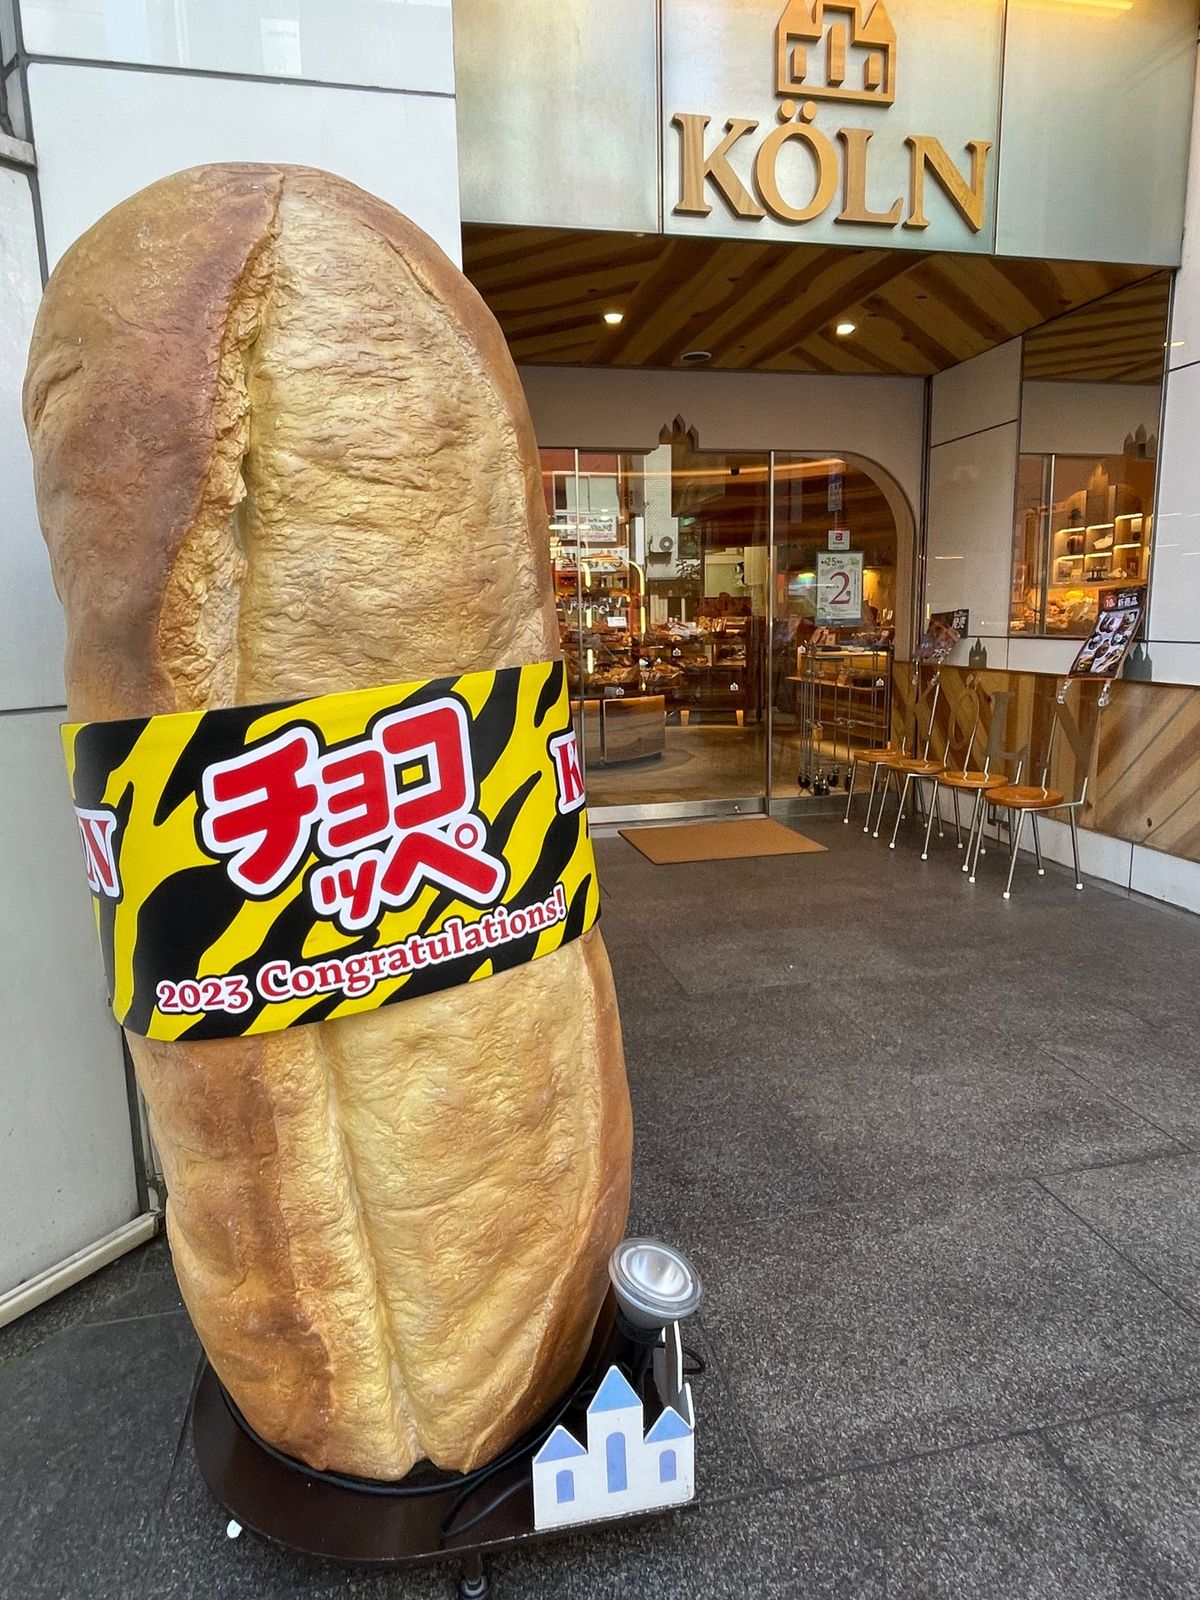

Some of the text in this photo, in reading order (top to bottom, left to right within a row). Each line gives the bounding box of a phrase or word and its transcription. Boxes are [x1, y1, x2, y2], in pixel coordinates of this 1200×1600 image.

[671, 99, 992, 234] KÖLN
[828, 571, 851, 605] 2
[157, 885, 567, 1014] 2023 Congratulations!
